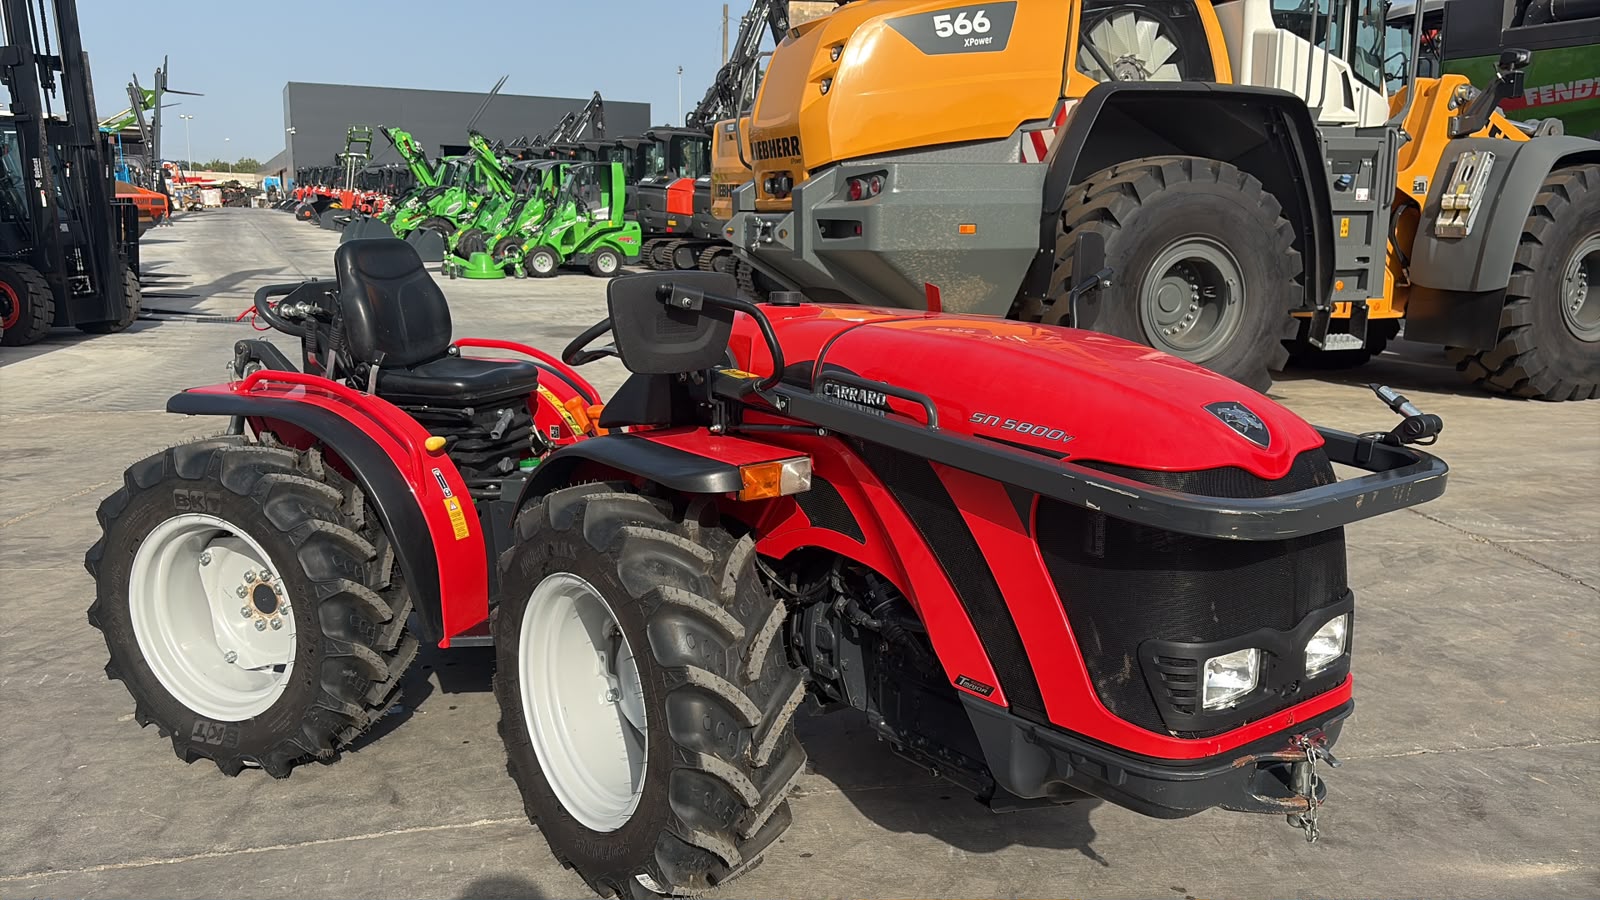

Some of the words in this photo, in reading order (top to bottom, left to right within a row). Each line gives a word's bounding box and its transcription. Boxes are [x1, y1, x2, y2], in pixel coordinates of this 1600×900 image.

[933, 10, 991, 38] 566
[963, 36, 993, 48] XPower
[750, 135, 802, 161] LIEBHERR
[823, 383, 887, 406] CARRARO
